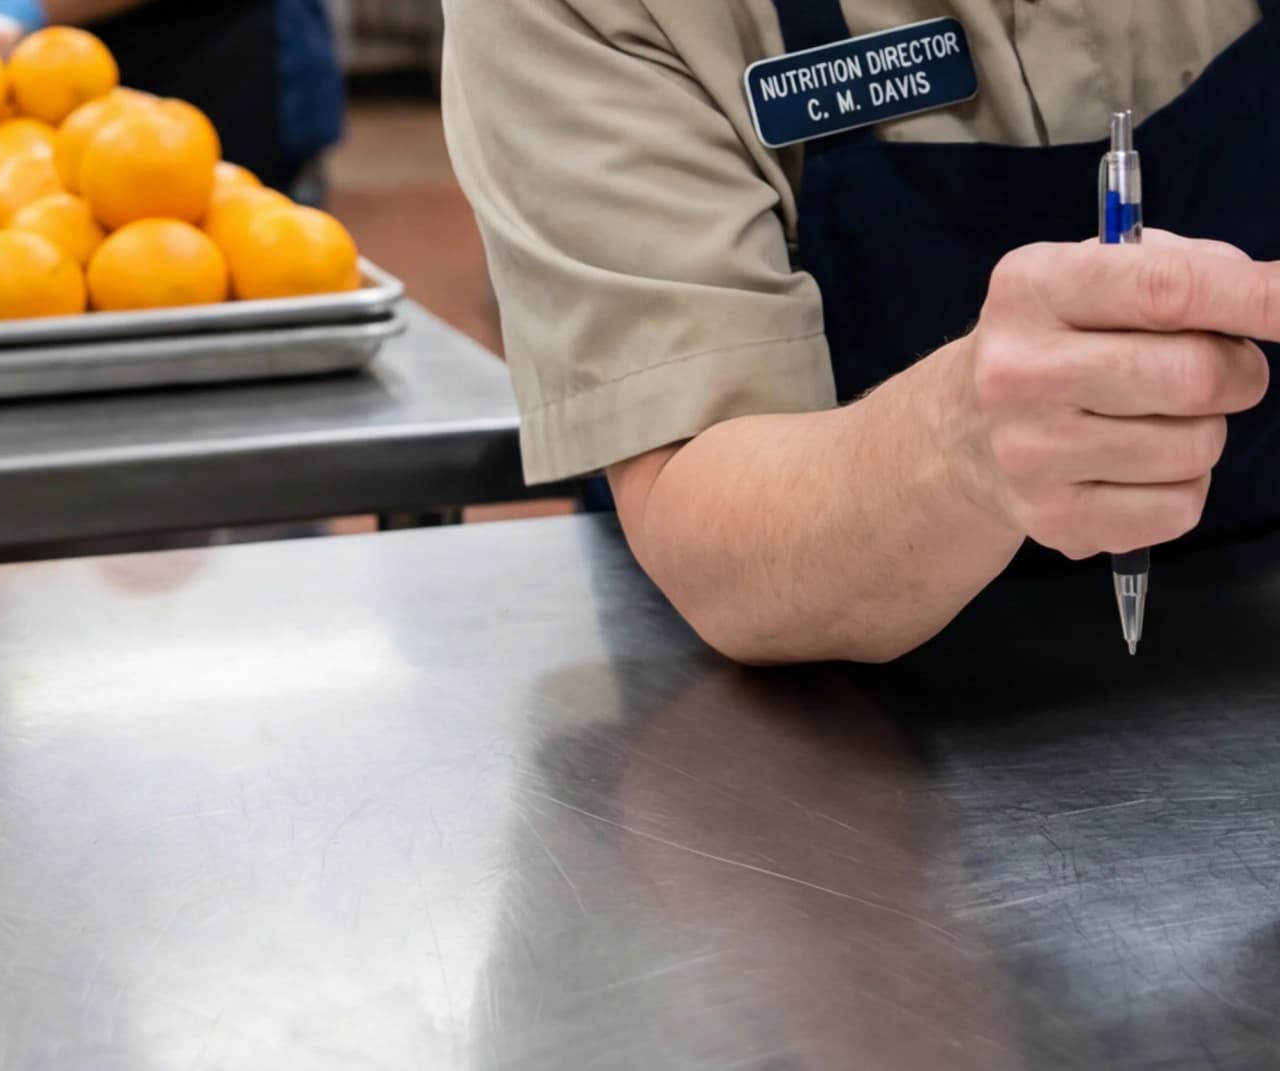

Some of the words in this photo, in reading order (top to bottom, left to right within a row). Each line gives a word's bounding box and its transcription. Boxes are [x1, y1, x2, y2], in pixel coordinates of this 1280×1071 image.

[759, 55, 863, 102] NUTRITION
[866, 31, 960, 76] DIRECTOR
[807, 98, 830, 121] C.
[836, 89, 862, 114] M.
[869, 71, 931, 106] DAVIS
